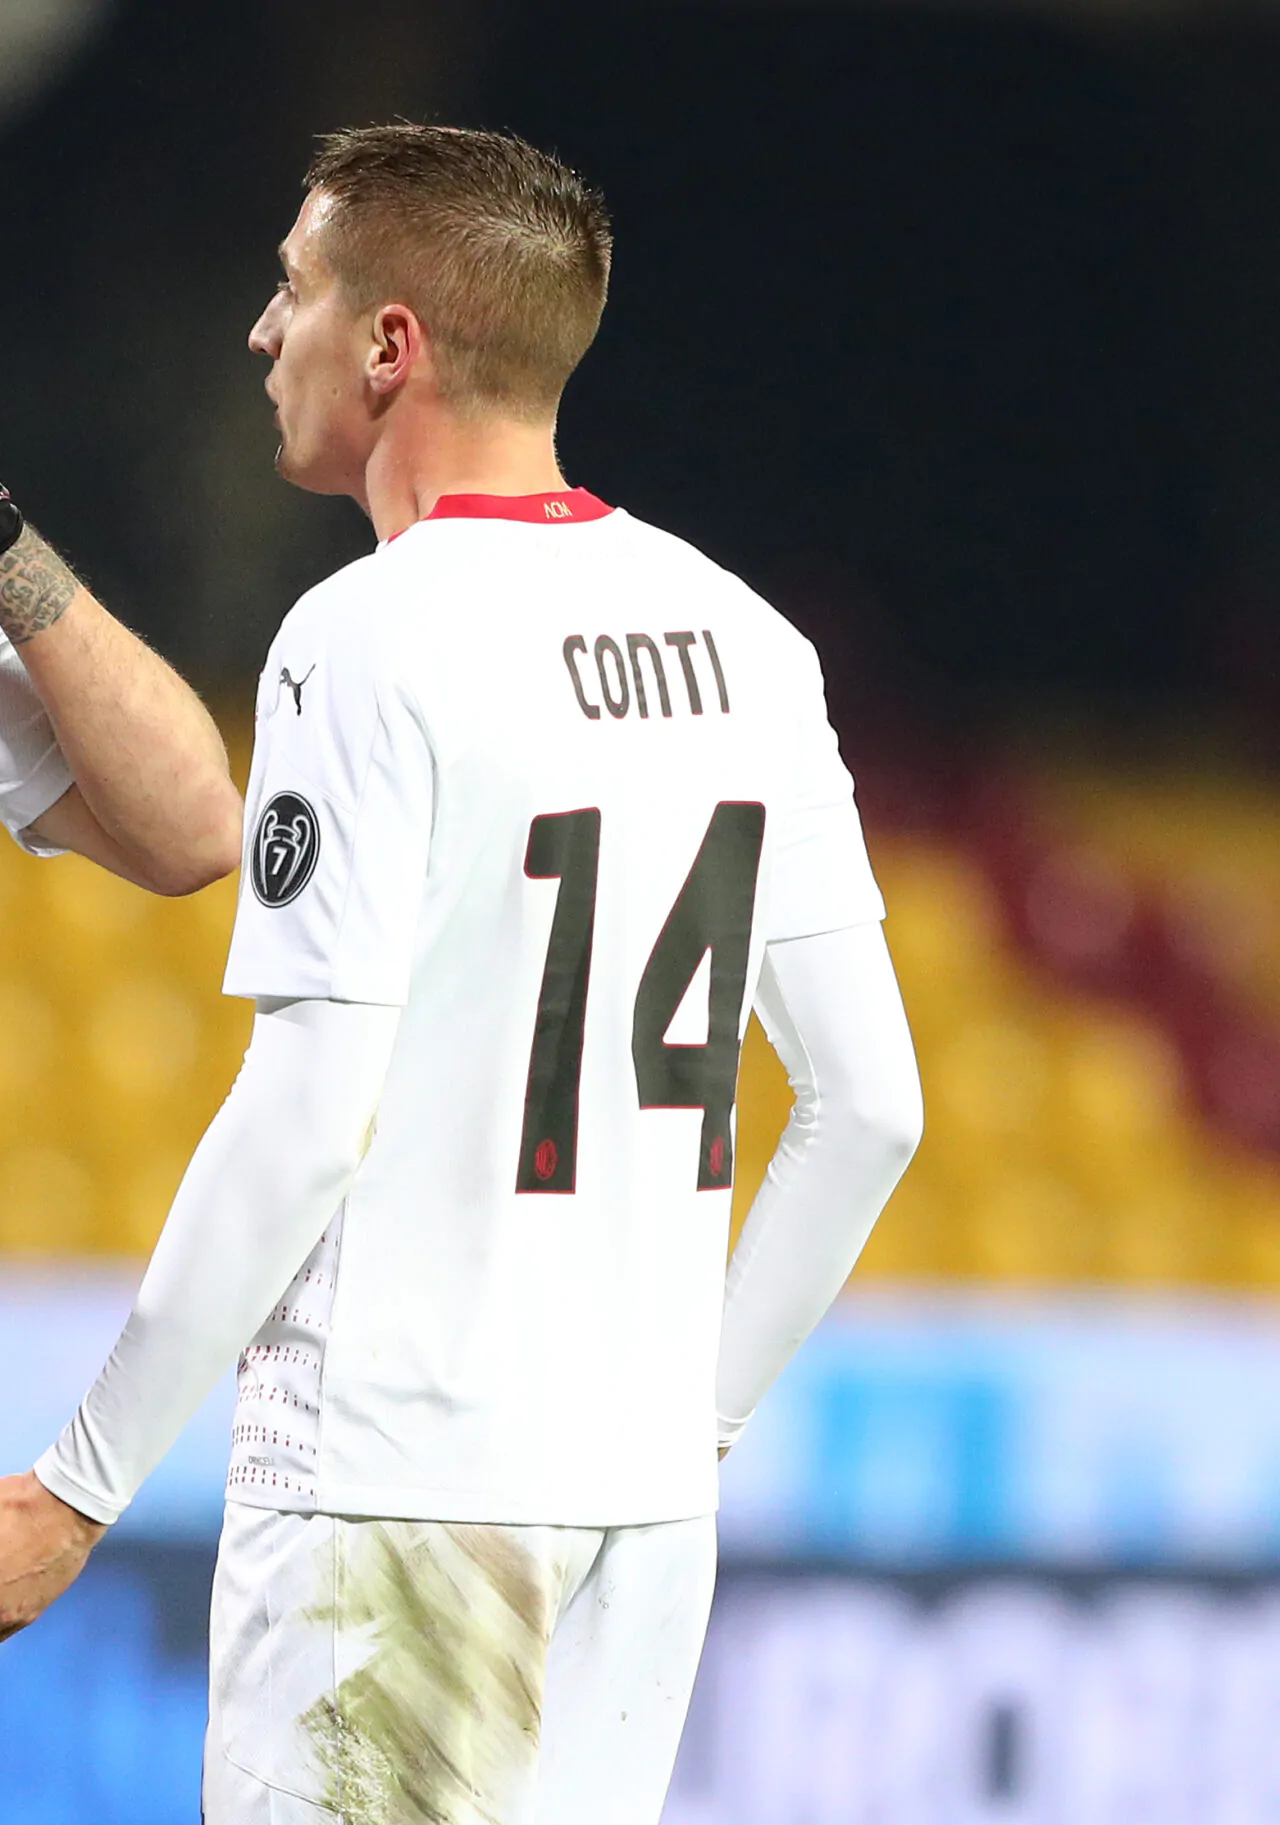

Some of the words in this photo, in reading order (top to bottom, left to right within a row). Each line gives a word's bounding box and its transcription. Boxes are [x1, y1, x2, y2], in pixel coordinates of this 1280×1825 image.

[543, 501, 573, 519] ACM
[563, 630, 730, 720] CONTI
[271, 846, 288, 875] 7
[515, 800, 767, 1195] 14
